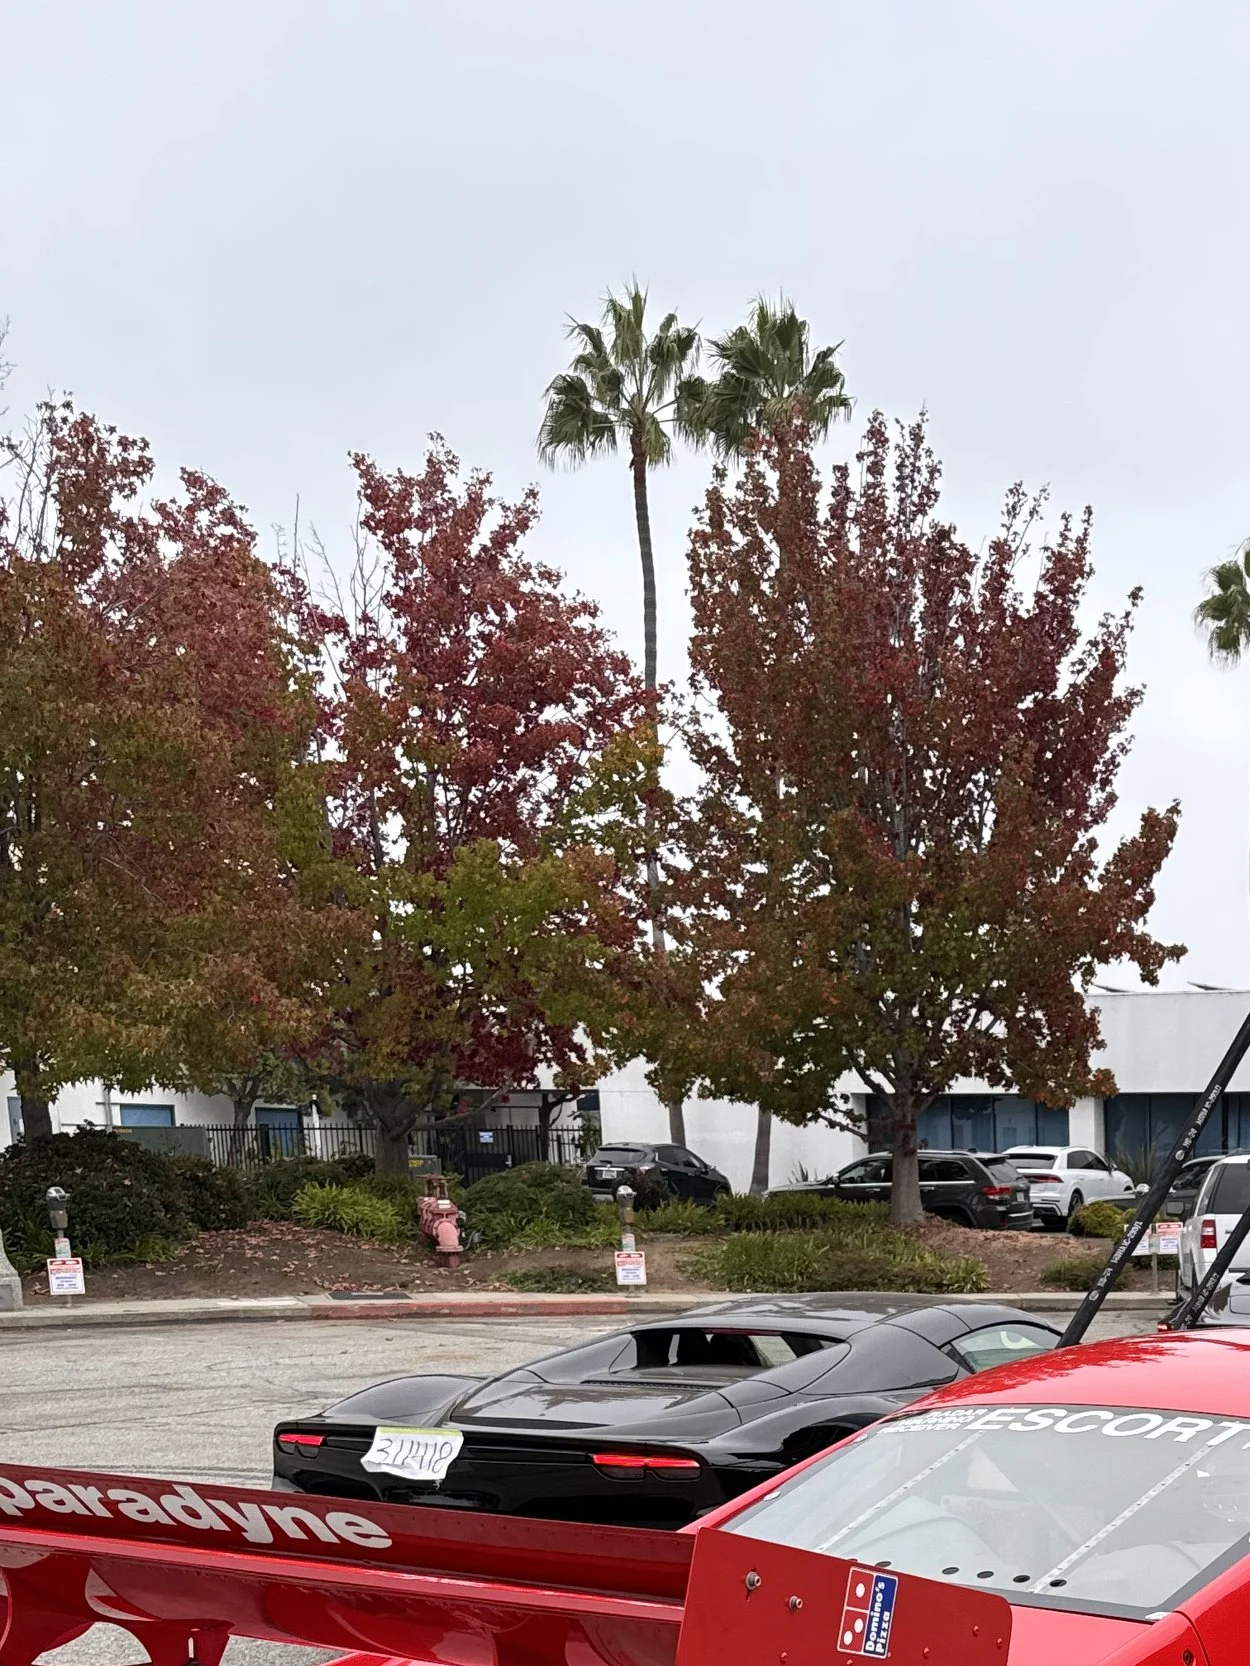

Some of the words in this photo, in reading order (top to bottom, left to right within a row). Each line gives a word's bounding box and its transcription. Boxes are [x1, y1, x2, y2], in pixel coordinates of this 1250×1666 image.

[0, 1480, 393, 1549] paradyne
[865, 1581, 885, 1651] Domino's
[875, 1611, 890, 1653] Pizza
